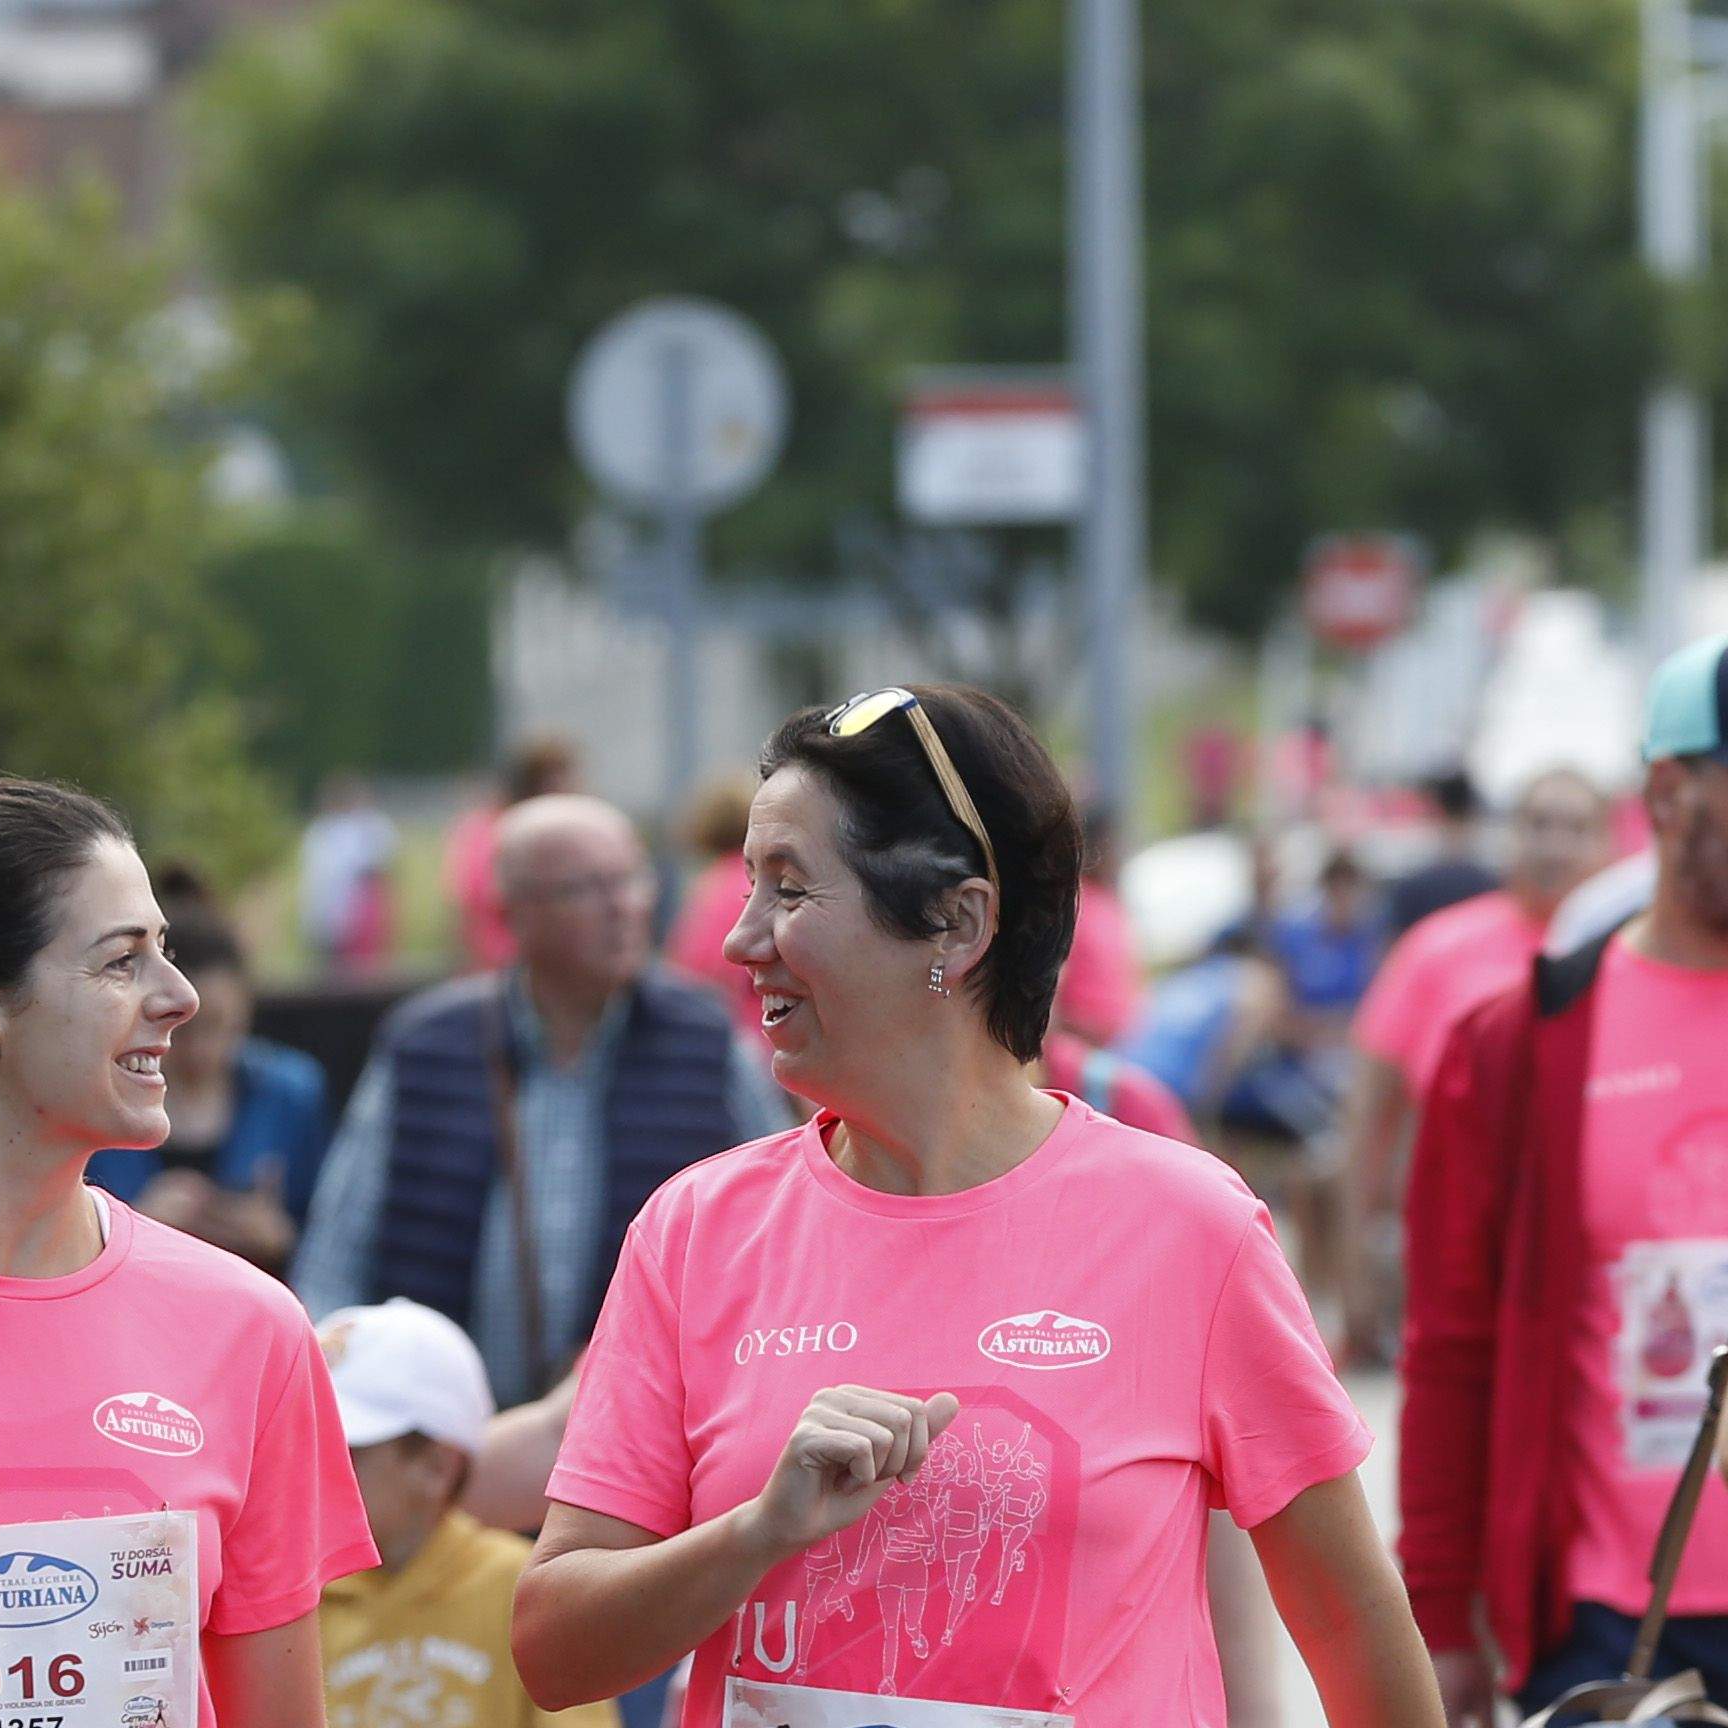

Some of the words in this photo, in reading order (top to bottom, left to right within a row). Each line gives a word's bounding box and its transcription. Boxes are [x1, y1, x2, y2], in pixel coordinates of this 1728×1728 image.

[735, 1321, 858, 1365] OYSHO
[987, 1330, 1101, 1355] ASTURIANA
[103, 1407, 197, 1448] ASTURIANA
[110, 1551, 125, 1561] TU
[128, 1546, 173, 1560] DORSAL
[31, 1574, 83, 1586] LECHERA
[111, 1559, 172, 1579] SUMA
